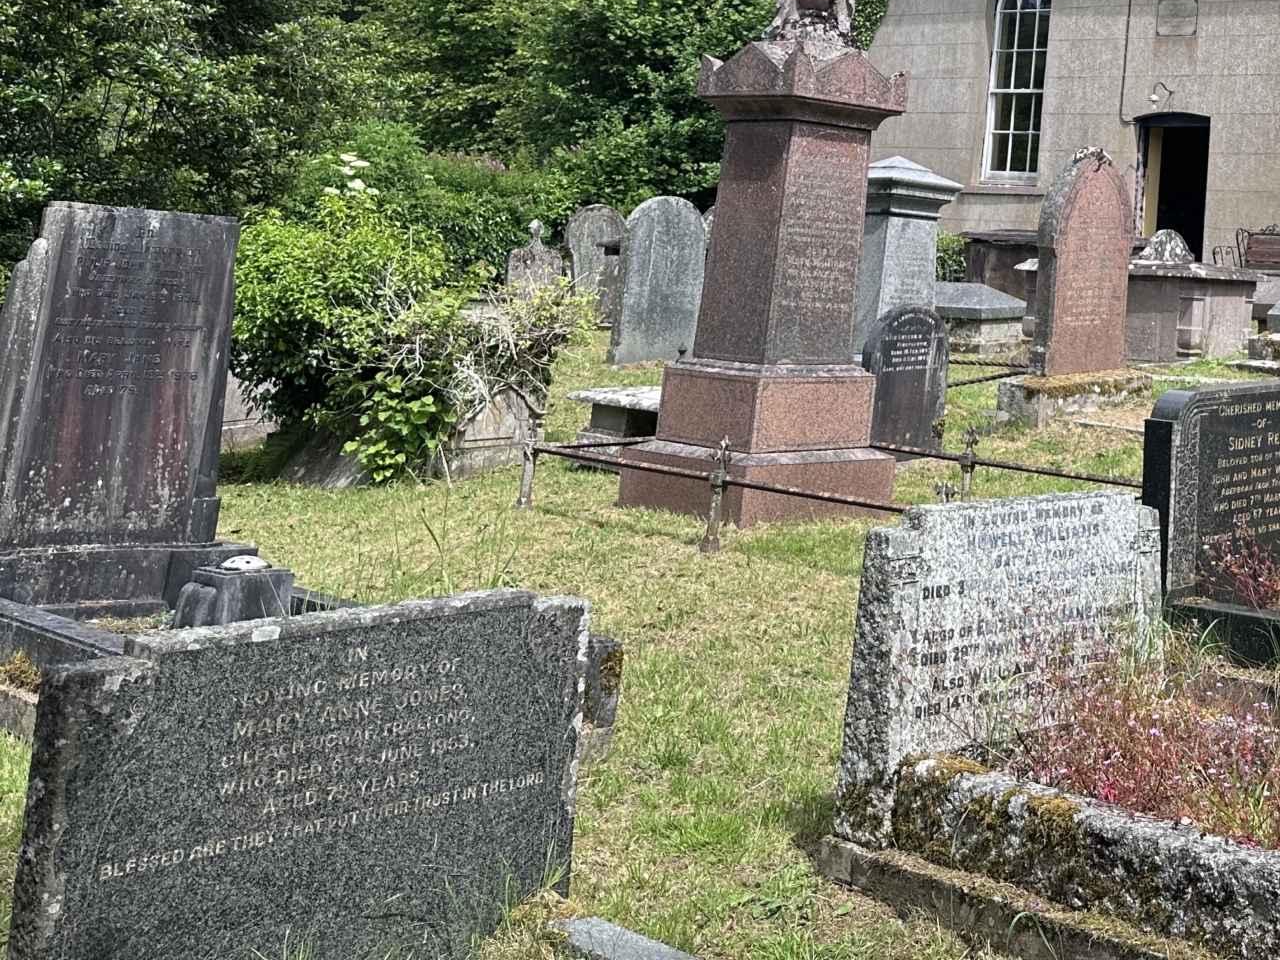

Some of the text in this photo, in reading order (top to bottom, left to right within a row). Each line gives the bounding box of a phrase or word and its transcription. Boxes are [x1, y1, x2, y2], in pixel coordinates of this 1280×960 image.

[76, 256, 113, 268] PHILIP
[115, 259, 145, 271] JOHN
[71, 287, 92, 298] WHO
[96, 288, 119, 299] DIED
[108, 305, 136, 315] AGED
[53, 333, 80, 344] ALSO
[84, 335, 103, 346] HIS
[107, 335, 155, 347] BELOVED
[77, 349, 161, 365] MARY JANE
[76, 367, 104, 380] DIED
[105, 369, 140, 380] APRIL
[84, 384, 115, 396] AGED
[1218, 402, 1262, 417] CHERISHED
[1228, 434, 1262, 451] SIDNEY
[1217, 456, 1248, 468] BELOVED
[1250, 454, 1263, 463] SON
[1264, 452, 1273, 460] OF
[1211, 473, 1231, 485] JOHN
[1233, 471, 1248, 481] AND
[1250, 467, 1272, 478] MARY
[1213, 502, 1229, 513] WHO
[1231, 499, 1247, 510] DIED
[1250, 495, 1262, 505] 7TH
[963, 501, 1103, 529] IN LOVING MEMORY OF
[1232, 512, 1251, 523] AGED
[1253, 508, 1263, 518] 67
[967, 522, 1100, 551] HOWELL WILLIAMS
[1257, 524, 1267, 534] NO
[922, 584, 951, 600] DIED
[922, 628, 955, 644] ALSO
[959, 626, 973, 640] OF
[347, 645, 368, 662] IN
[920, 650, 948, 667] DIED
[241, 657, 461, 708] LOVING MEMORY OF
[932, 675, 964, 691] ALSO
[914, 701, 941, 719] DIED
[946, 693, 973, 713] 14TH
[233, 706, 312, 742] MARY
[318, 695, 382, 724] ANNE
[217, 774, 266, 796] WHO
[275, 763, 323, 786] DIED
[375, 743, 422, 765] JUNE
[262, 791, 318, 817] AGED
[357, 770, 420, 798] YEARS
[99, 771, 544, 880] BLESSED ARE THEY THAT PUT THEIR TRUST IN THE LORD
